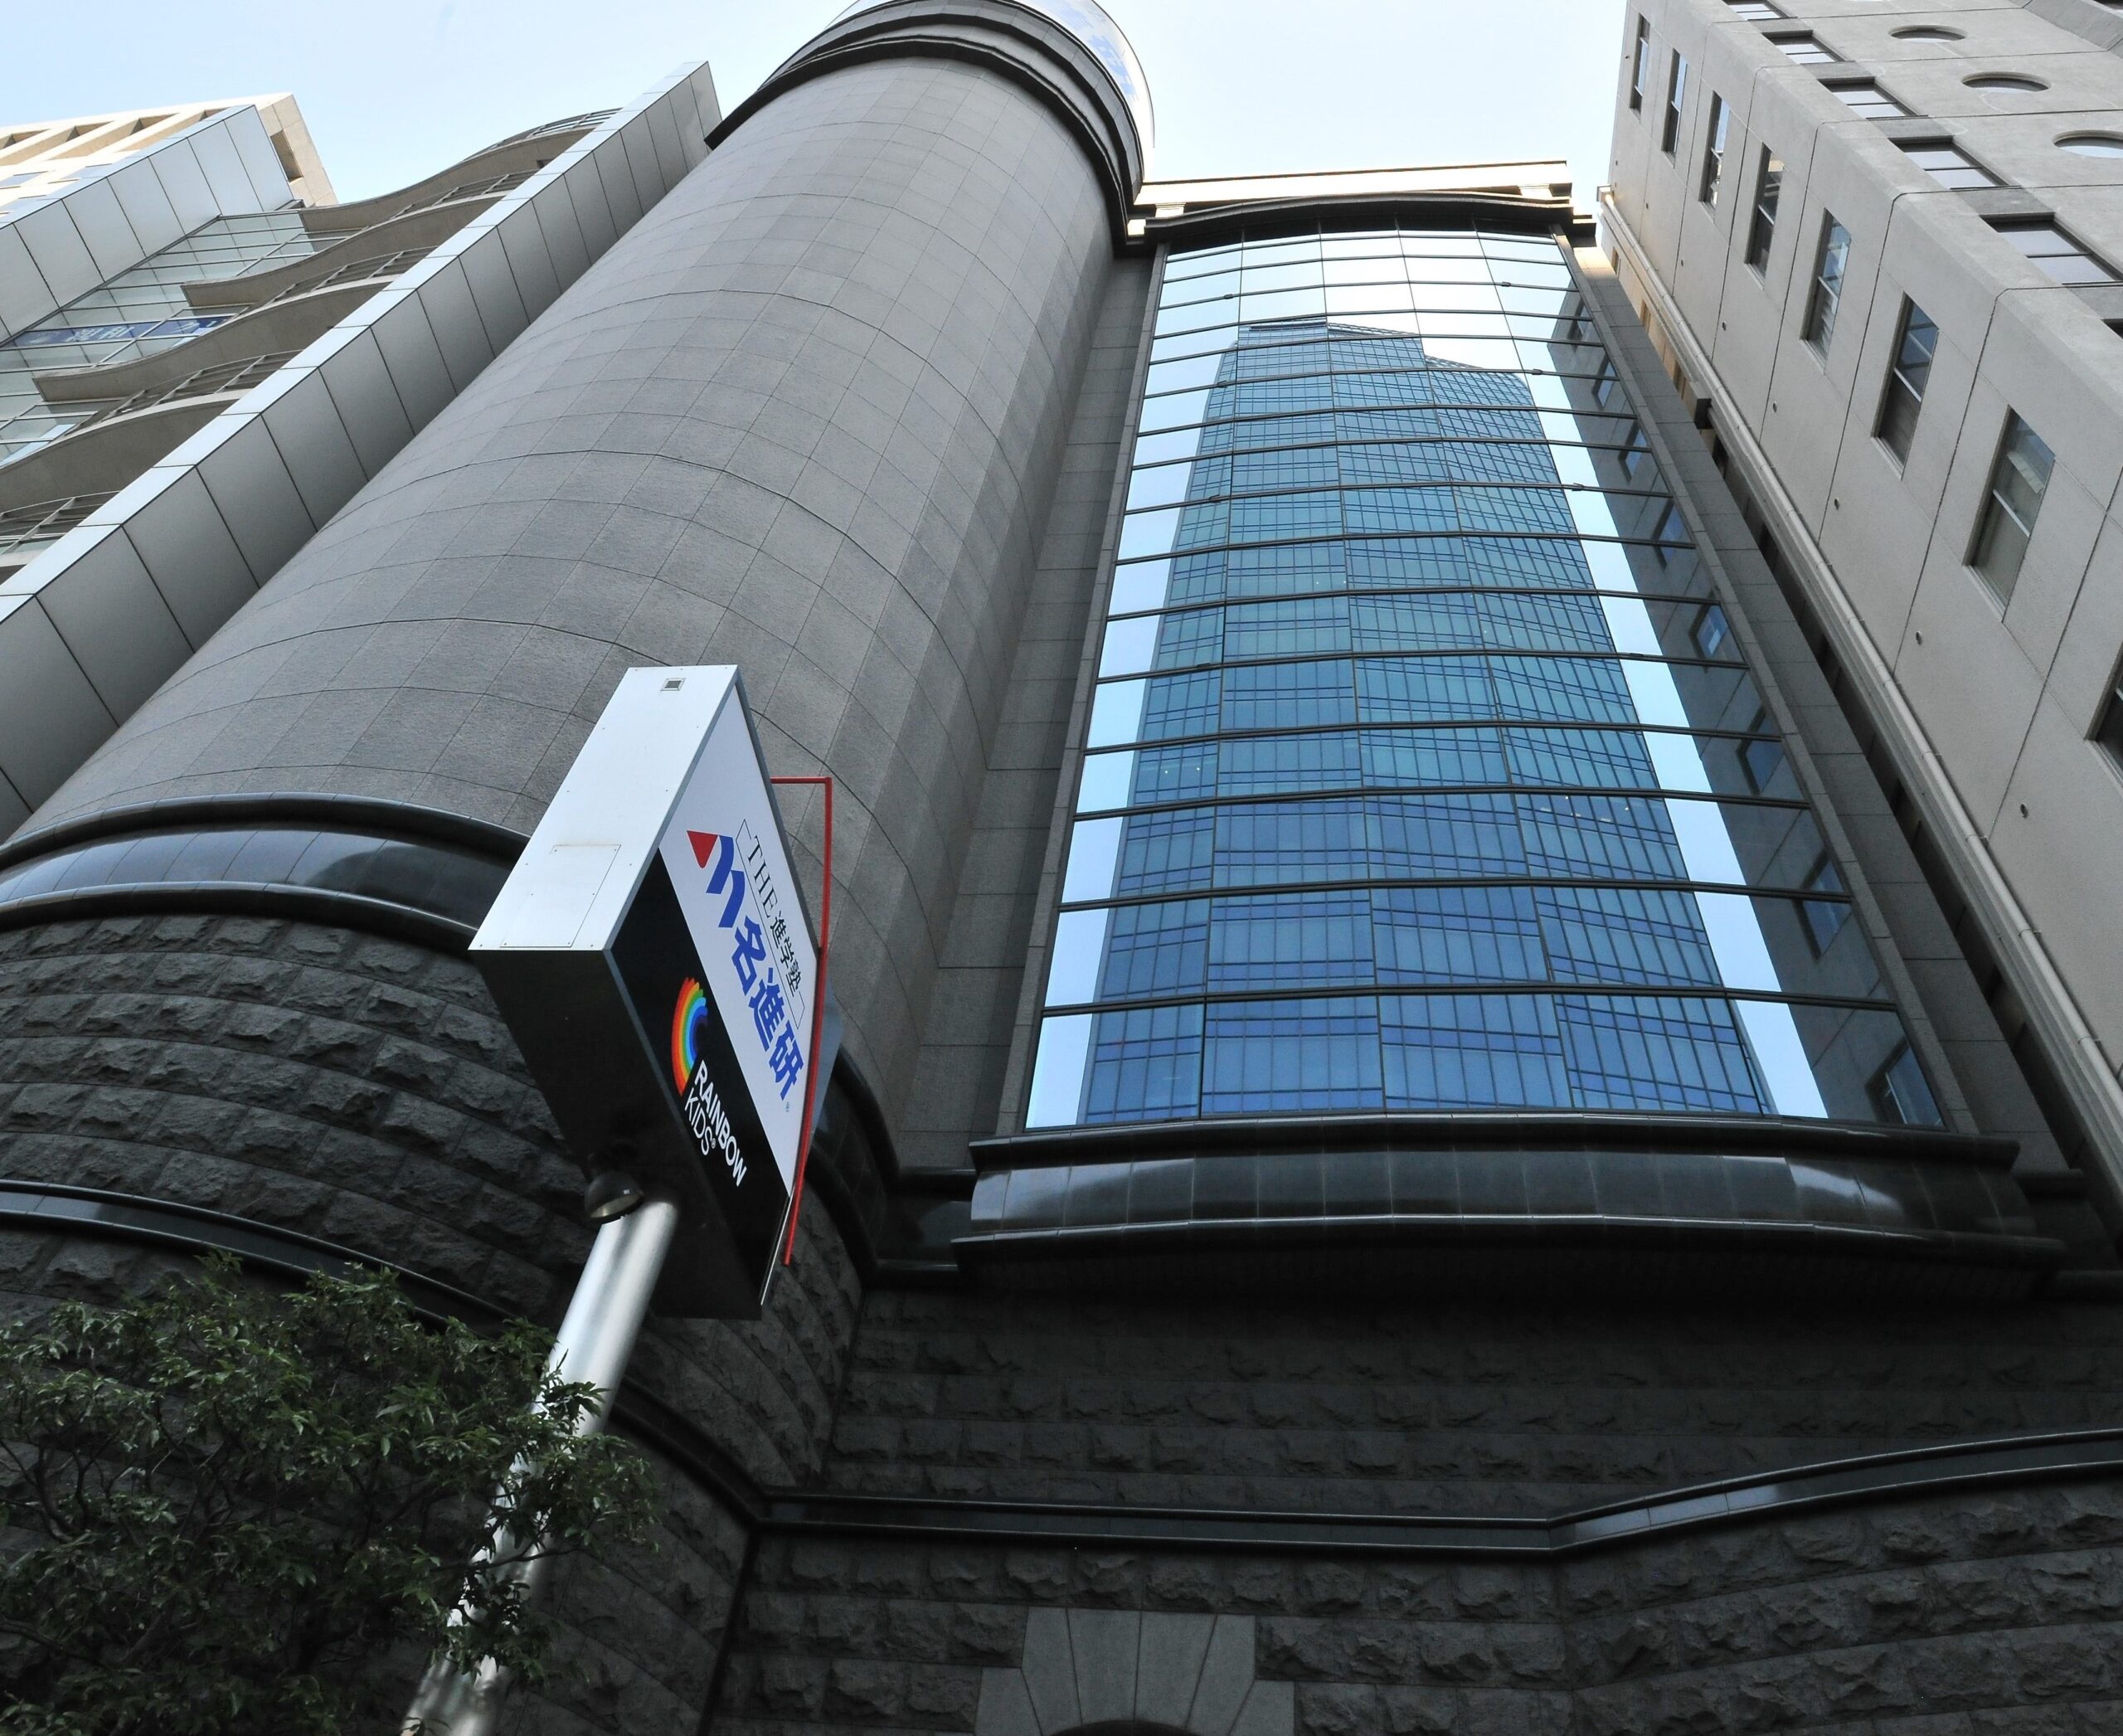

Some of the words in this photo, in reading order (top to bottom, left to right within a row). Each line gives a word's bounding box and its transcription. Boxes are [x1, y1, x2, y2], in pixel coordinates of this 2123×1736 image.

[731, 916, 804, 1101] 名進研
[694, 1059, 747, 1187] RAINBOW
